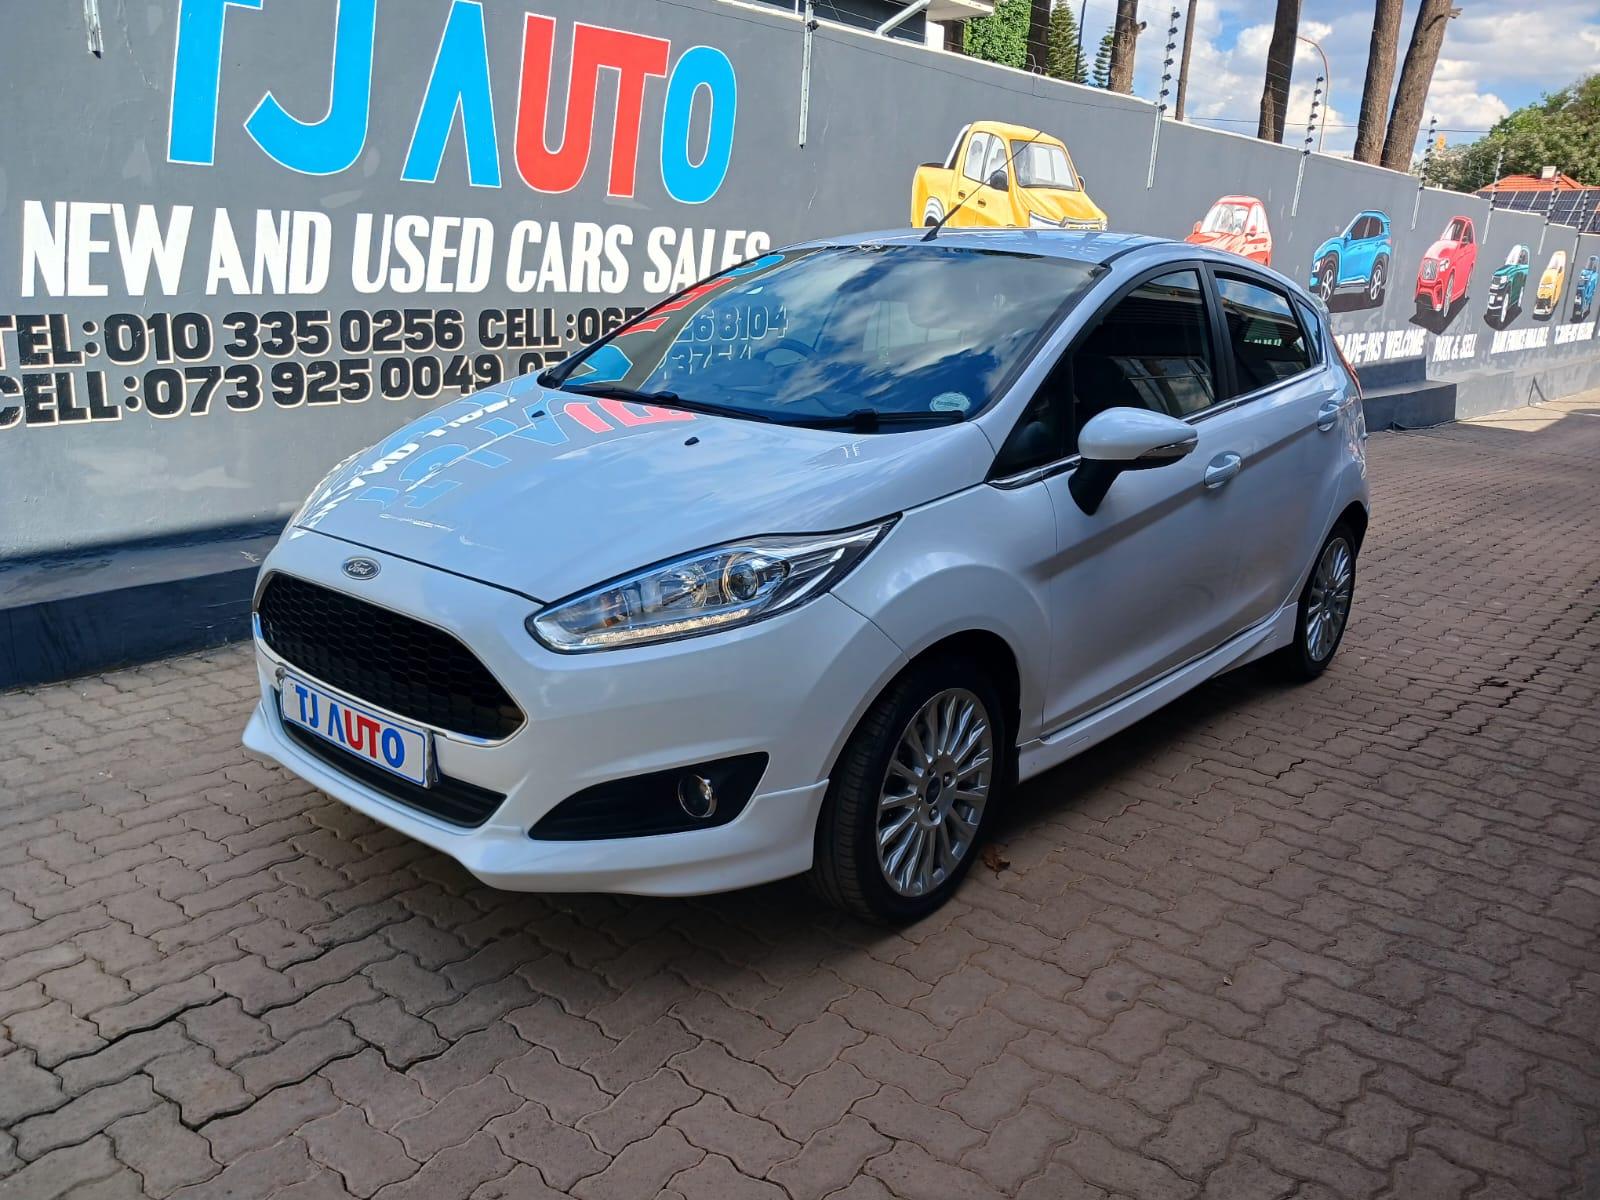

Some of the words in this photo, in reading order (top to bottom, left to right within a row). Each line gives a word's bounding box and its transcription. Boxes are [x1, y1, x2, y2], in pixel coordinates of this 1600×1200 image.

[166, 0, 377, 176] TJ
[399, 0, 738, 204] AUTO
[20, 200, 193, 298] NEW
[205, 207, 332, 296] AND
[351, 214, 493, 293] USED
[505, 221, 634, 293] CARS
[222, 310, 331, 361] 335
[339, 308, 465, 355] 0256
[1383, 328, 1427, 360] WELCOME
[1432, 335, 1453, 362] PARK
[1460, 333, 1478, 359] SELL
[270, 357, 373, 409] 925
[380, 353, 505, 400] 0049
[347, 560, 373, 575] Ford
[295, 684, 320, 729] TJ
[327, 703, 405, 769] AUTO
